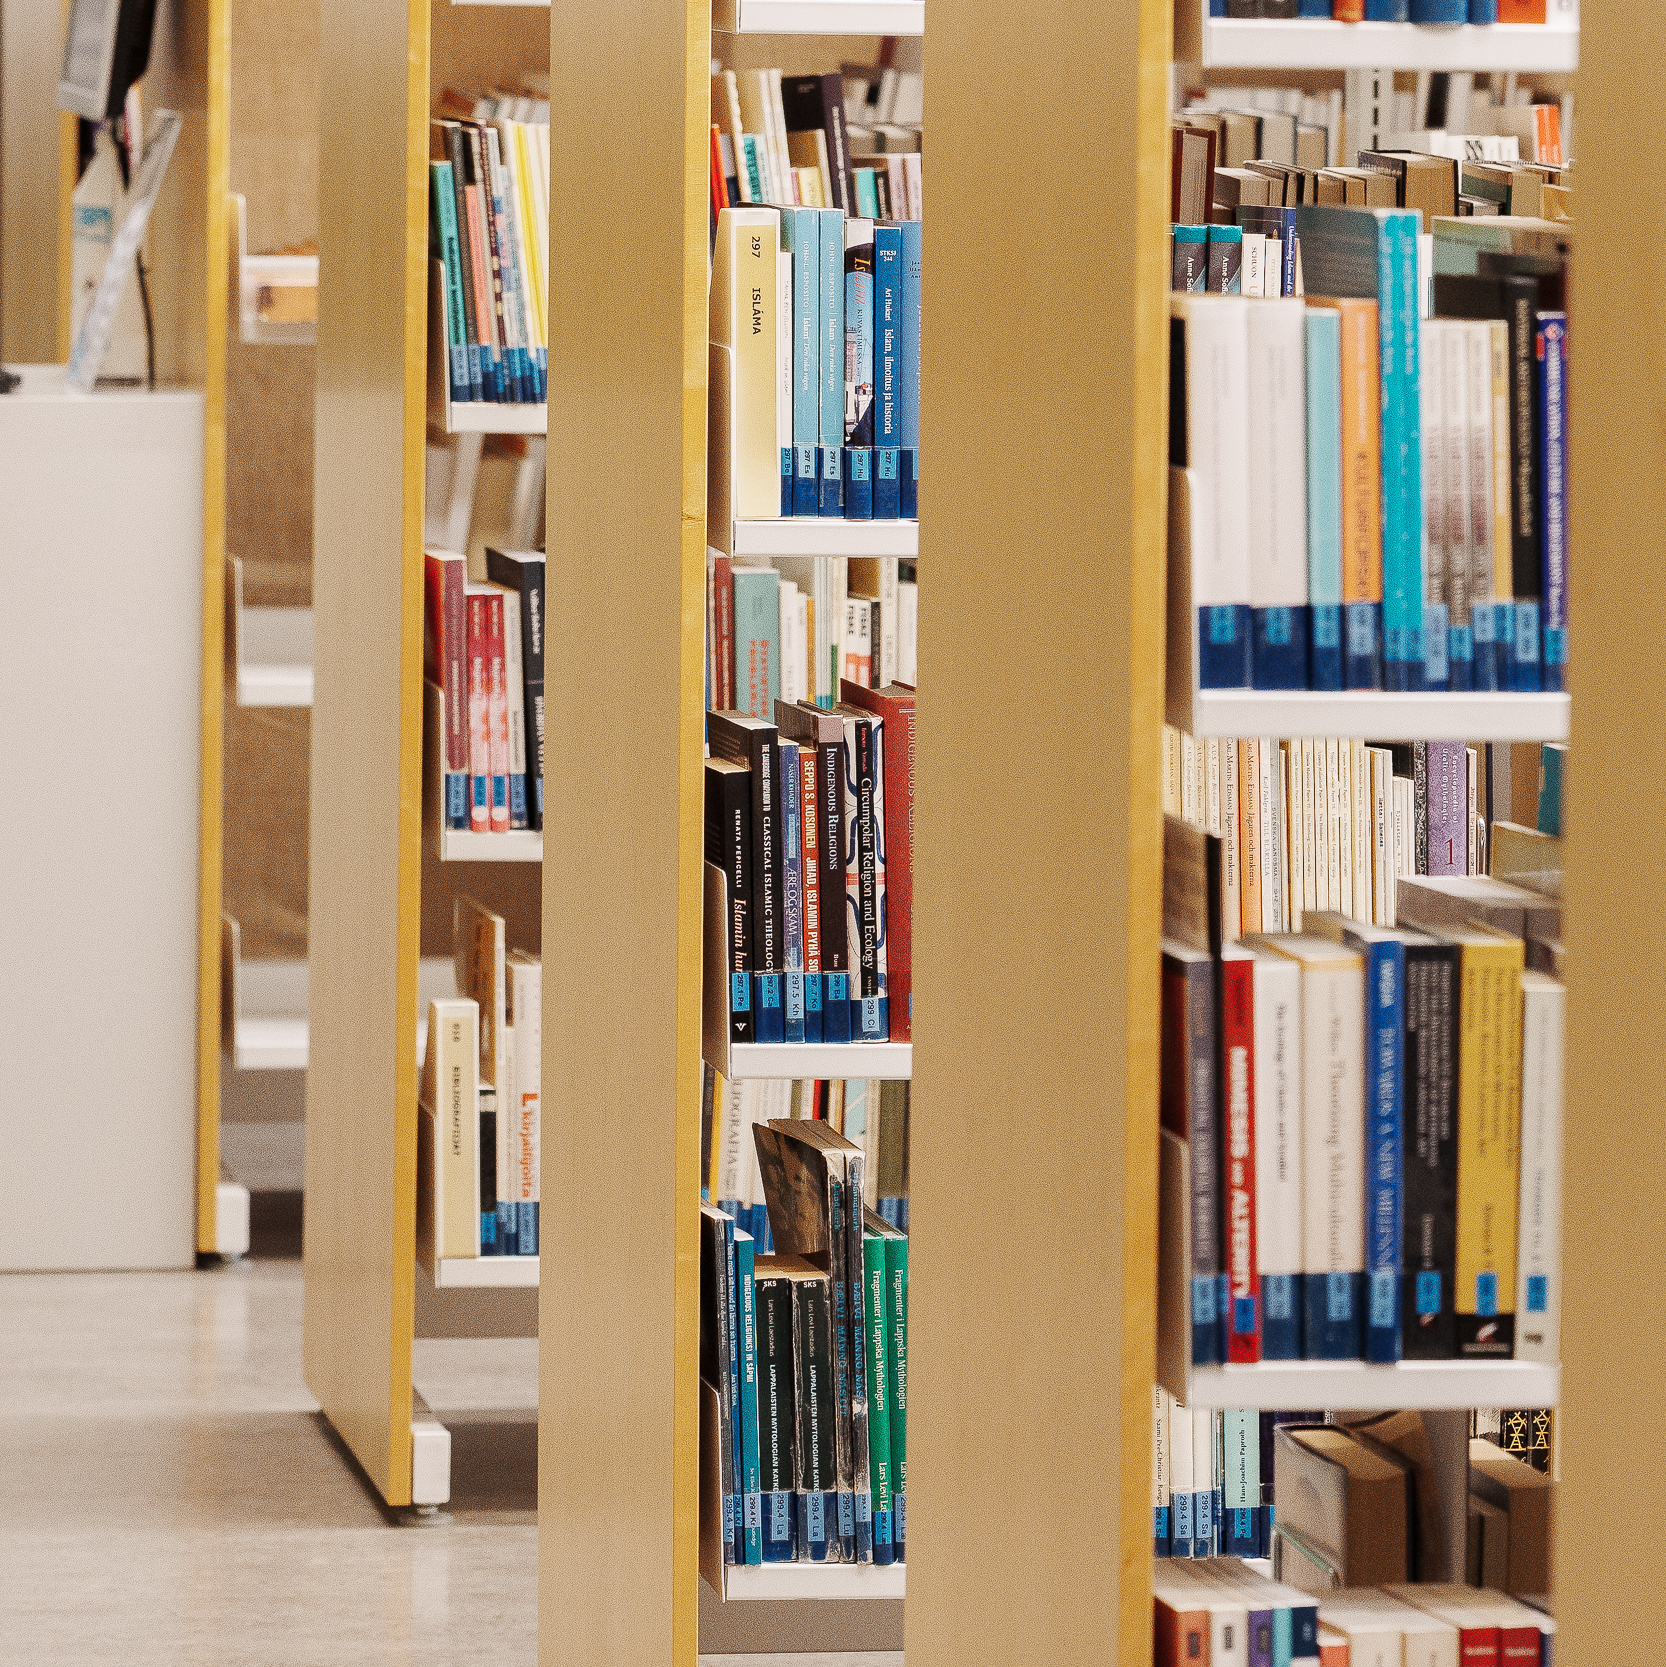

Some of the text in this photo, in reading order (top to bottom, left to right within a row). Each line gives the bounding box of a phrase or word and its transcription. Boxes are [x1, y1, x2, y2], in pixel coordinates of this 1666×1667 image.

[751, 236, 761, 258] 297
[1286, 226, 1295, 260] Understanding
[854, 257, 871, 304] Islam
[752, 287, 764, 335] ISLÁMA
[882, 328, 894, 353] Islam,
[884, 356, 894, 391] ilmoitus
[883, 392, 893, 401] ja
[884, 402, 894, 435] historia
[804, 464, 811, 474] Es
[884, 451, 892, 477] 297 Hu
[762, 744, 770, 753] THE
[804, 761, 815, 790] SEPPO
[1441, 748, 1449, 824] Uralic Mythologies
[1451, 755, 1459, 824] Encyclopaedia of
[804, 793, 815, 802] S.
[827, 748, 839, 870] INDIGENOUS RELIGIONS
[860, 778, 874, 848] Circumpolar
[805, 805, 816, 848] KOSONEN
[1225, 812, 1235, 837] Jägaren
[1245, 812, 1255, 837] Jägaren
[1227, 839, 1235, 852] och
[1444, 837, 1455, 866] 1
[788, 867, 797, 890] ÆRE
[805, 857, 816, 887] JIHAD,
[861, 852, 874, 896] Religion
[1248, 854, 1256, 887] makterna
[764, 873, 772, 915] ISLAMIC
[788, 891, 797, 907] OG
[807, 890, 817, 929] ISLAMIN
[864, 900, 875, 922] and
[789, 908, 798, 935] SKAM
[765, 918, 773, 973] THEOLOGY
[808, 931, 820, 957] PYHÄ
[862, 925, 875, 969] Ecology
[737, 996, 744, 1006] Pe
[792, 975, 800, 1016] 297.5 Kh
[744, 1274, 752, 1313] INDIGENOUS
[871, 1270, 882, 1317] Fragmenter
[745, 1314, 753, 1352] RELIGION(S)
[873, 1324, 883, 1359] Lappska
[745, 1353, 753, 1361] IN
[770, 1364, 778, 1416] LAPPALAISTEN
[810, 1365, 818, 1417] LAPPALAISTEN
[875, 1360, 885, 1411] Mythologien
[771, 1418, 779, 1467] MYTOLOGIAN
[812, 1419, 820, 1468] MYTOLOGIAN
[878, 1462, 887, 1480] Lars
[1239, 1429, 1247, 1502] Hans-Joachim Paproth
[879, 1482, 888, 1498] Levi
[726, 1498, 734, 1540] 299.4 Kr
[749, 1496, 757, 1526] 299.4 Kr
[812, 1496, 820, 1537] 299.4 La
[843, 1494, 851, 1535] 299.4 Lu
[1201, 1495, 1209, 1535] 299.4 Sa
[777, 1524, 784, 1535] La
[1180, 1524, 1187, 1535] Sa
